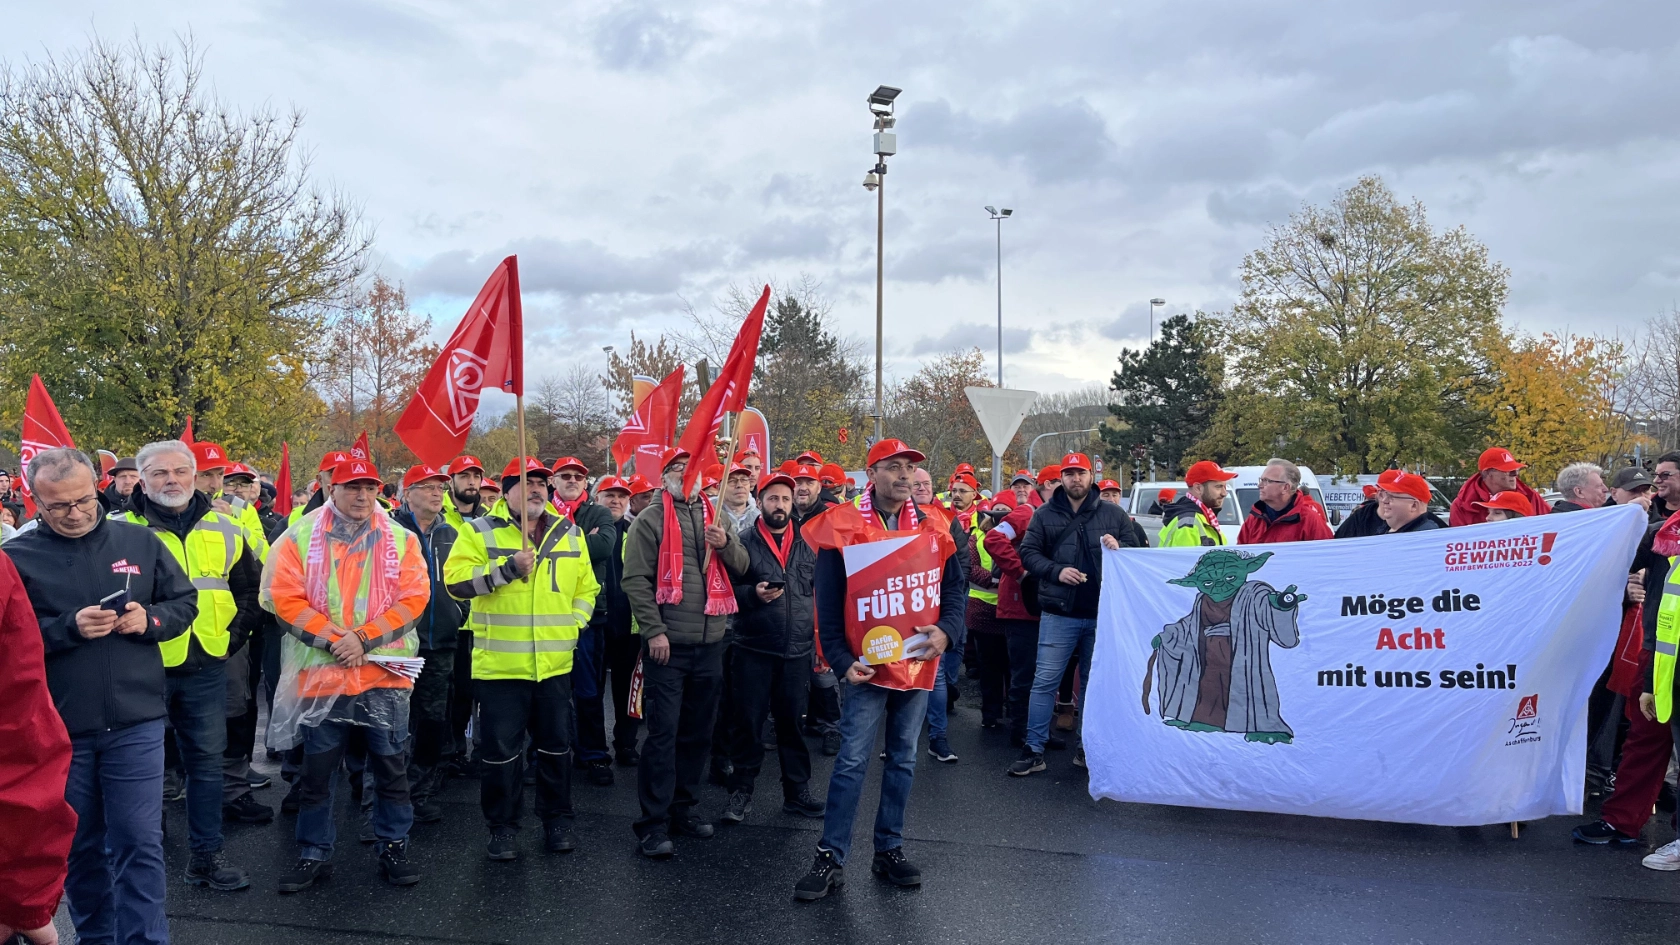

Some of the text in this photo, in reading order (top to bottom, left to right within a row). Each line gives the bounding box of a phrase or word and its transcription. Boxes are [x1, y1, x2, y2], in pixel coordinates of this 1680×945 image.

[1446, 535, 1538, 552] SOLIDARITÄT
[1445, 560, 1533, 572] TARIFBEWEGUNG 2022
[887, 576, 903, 592] ES
[906, 572, 925, 588] IST
[857, 588, 906, 622] FÜR
[1341, 588, 1481, 620] Möge die
[867, 640, 899, 654] STREITEN
[870, 635, 893, 646] DAFÜR
[1375, 627, 1446, 650] Acht
[876, 650, 894, 660] WIR!
[1317, 663, 1517, 689] mit uns sein!
